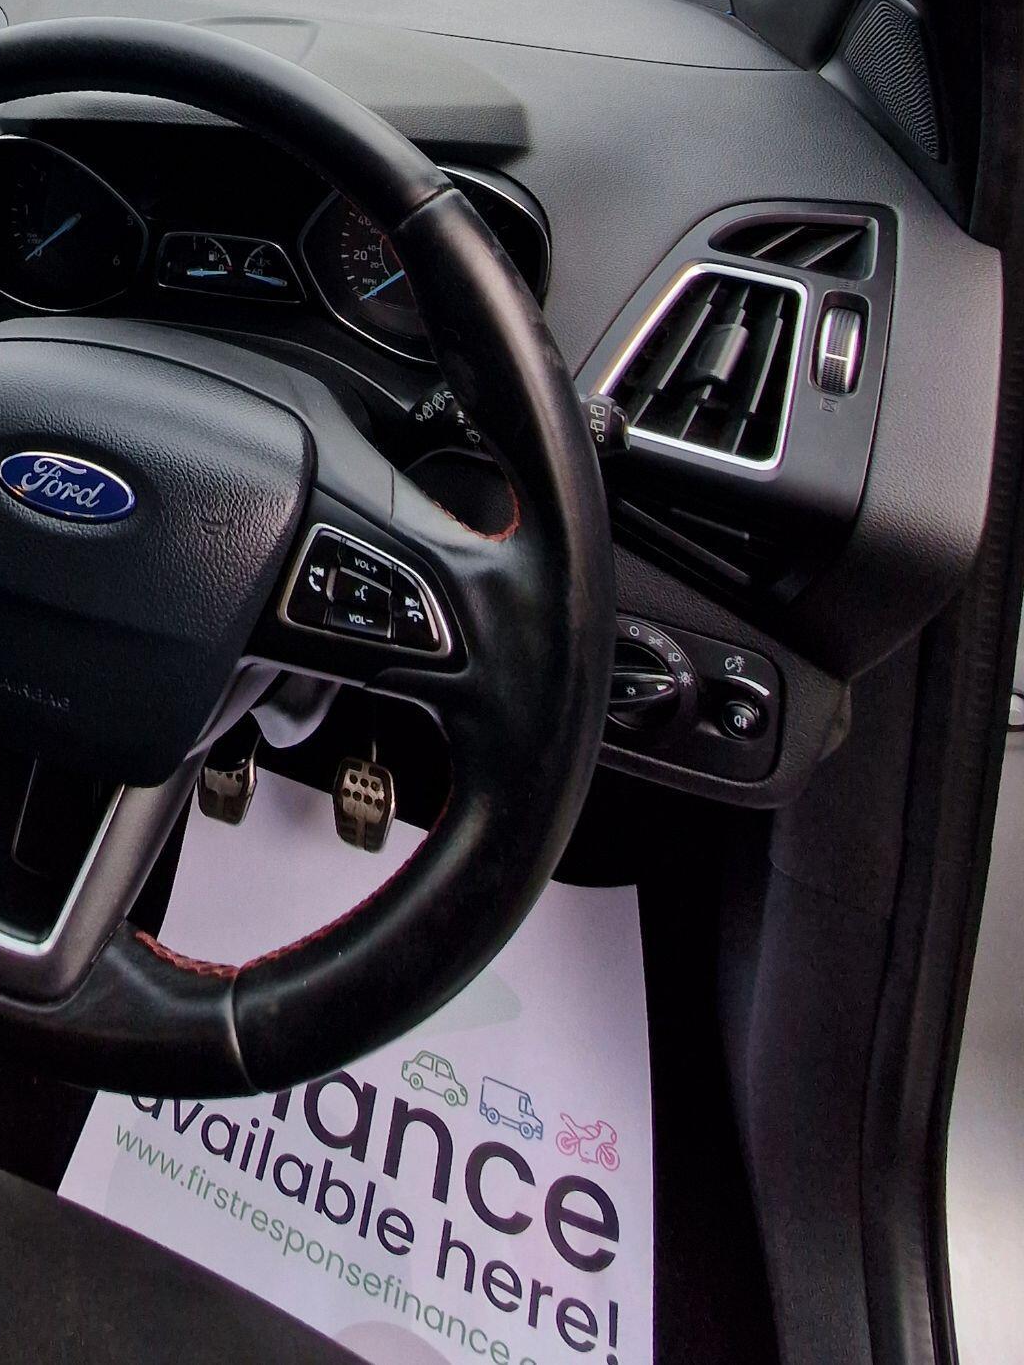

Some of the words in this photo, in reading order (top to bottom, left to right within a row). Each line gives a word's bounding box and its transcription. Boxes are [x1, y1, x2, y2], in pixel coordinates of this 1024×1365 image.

[111, 253, 121, 267] 6
[353, 249, 368, 261] 20
[20, 457, 106, 508] Ford
[272, 1069, 621, 1273] ance
[115, 1124, 538, 1365] www.firstresponsefinance
[436, 1219, 620, 1365] here!
